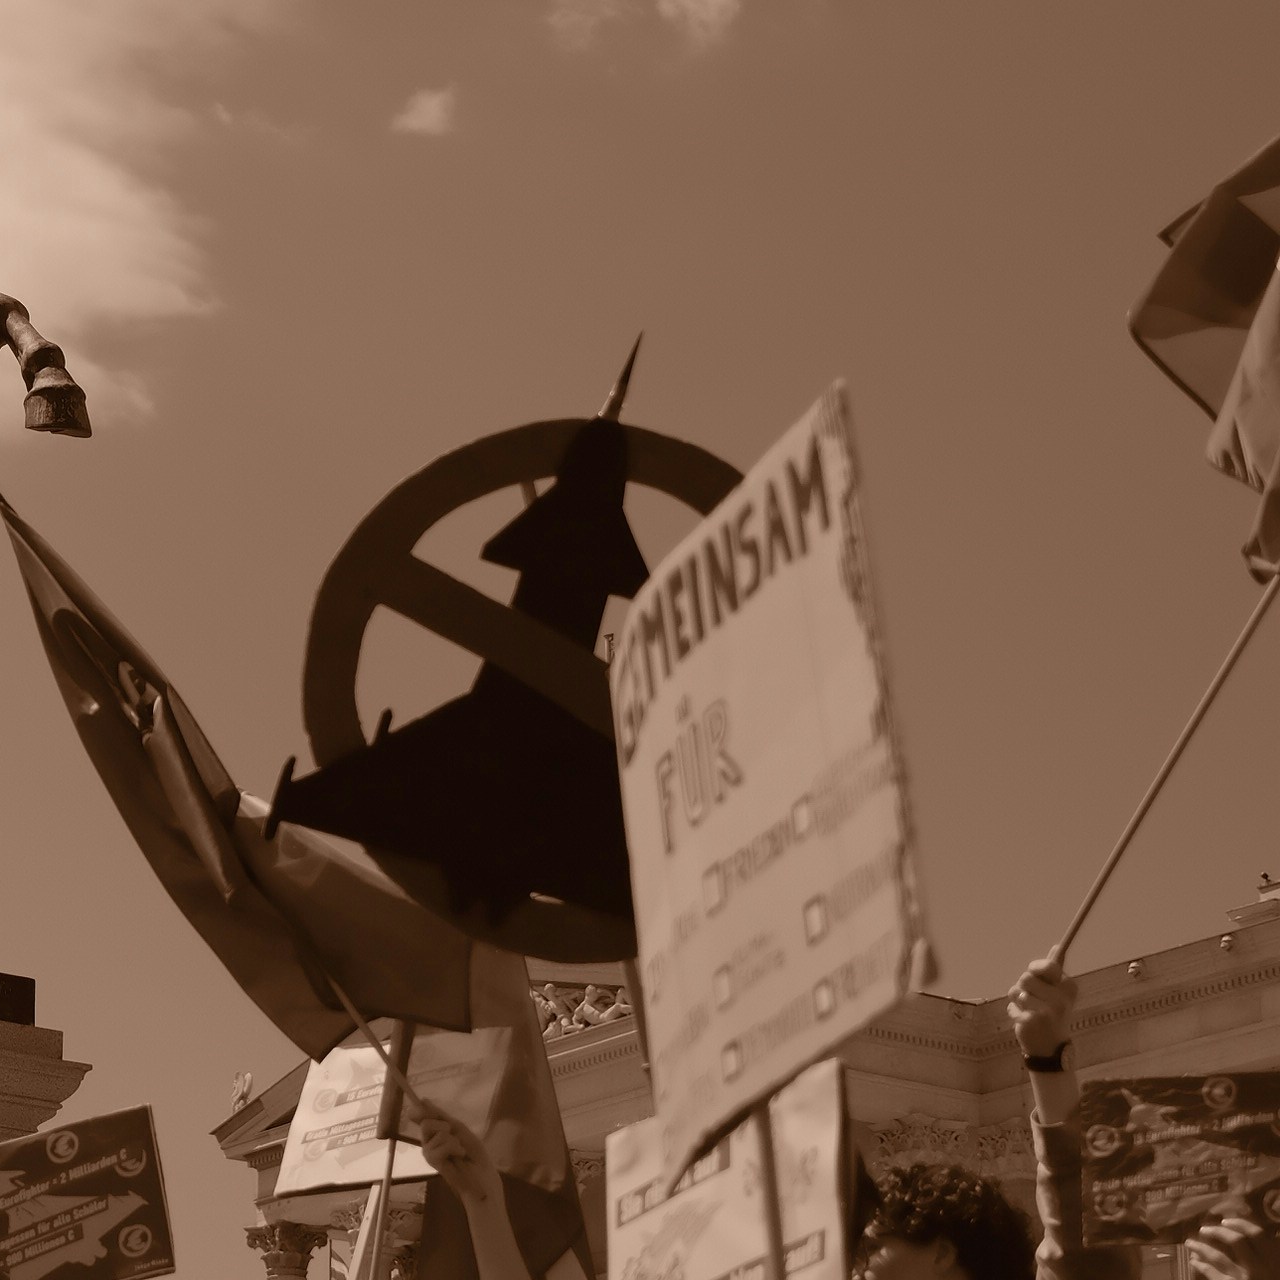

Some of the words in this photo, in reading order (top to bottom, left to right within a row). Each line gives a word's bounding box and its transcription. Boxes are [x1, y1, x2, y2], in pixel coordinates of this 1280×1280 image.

[655, 693, 746, 856] FÜR
[60, 1173, 68, 1184] 2
[68, 1153, 119, 1182] Milliarden
[37, 1219, 50, 1234] für
[52, 1213, 72, 1230] alle
[72, 1198, 108, 1220] Schüler
[24, 1234, 67, 1262] Millionen
